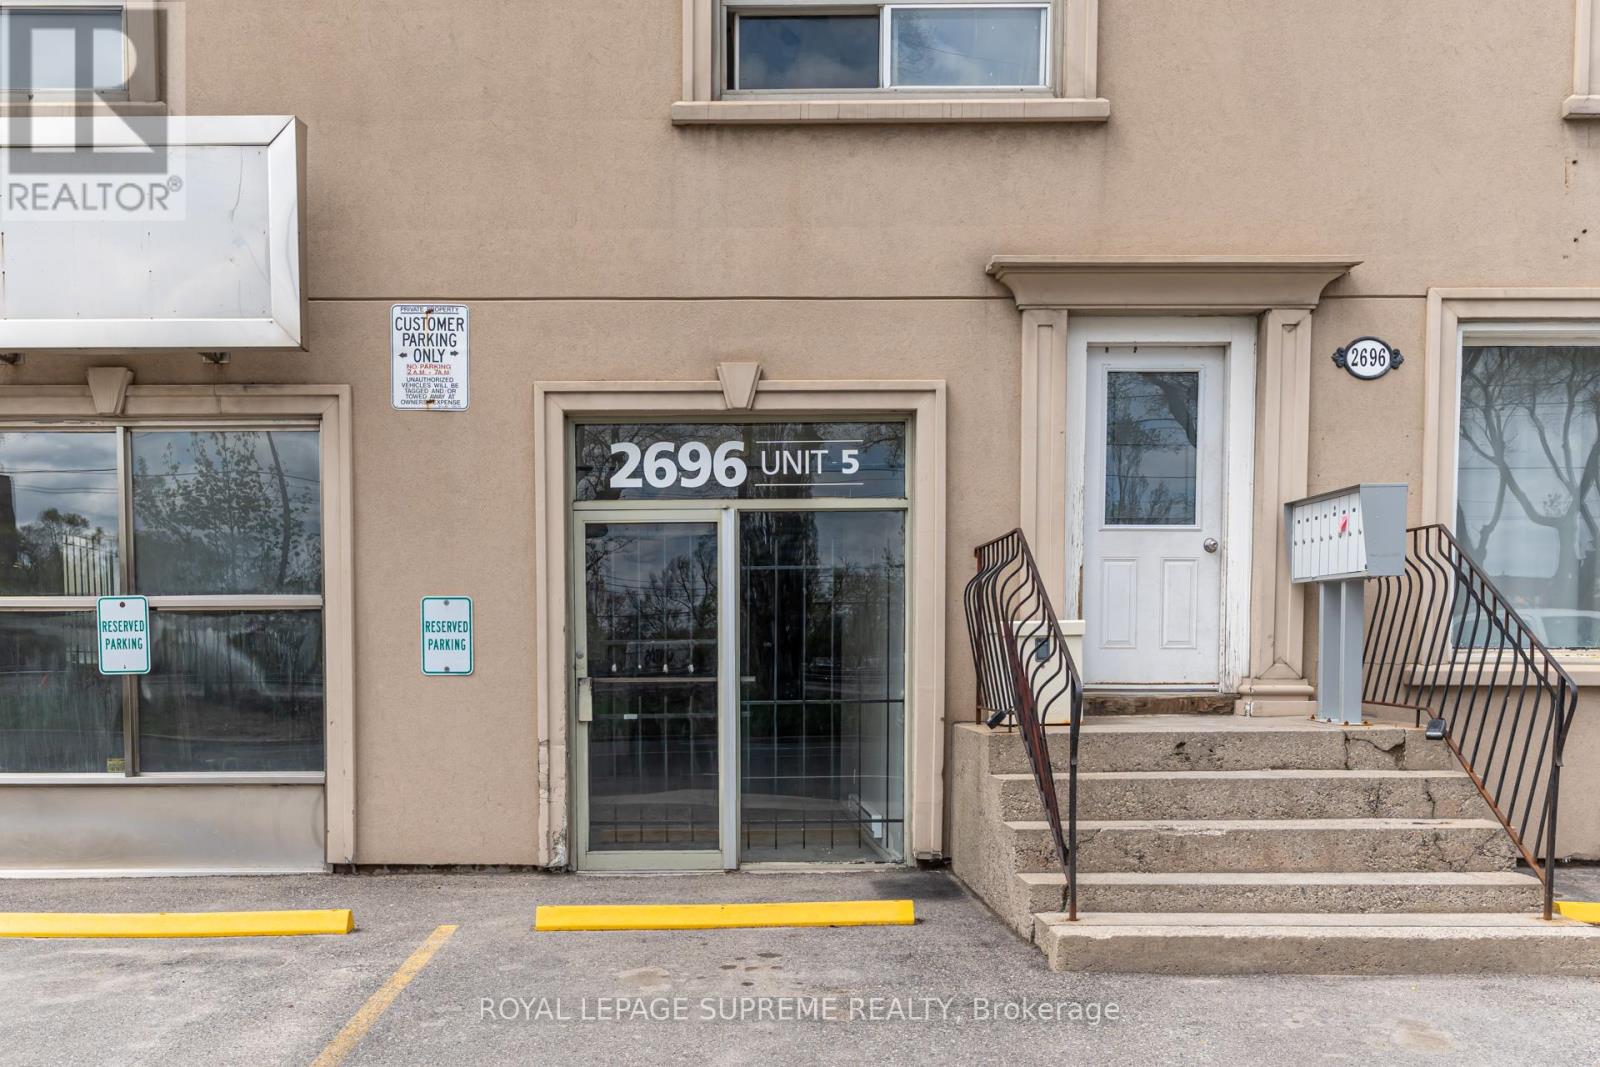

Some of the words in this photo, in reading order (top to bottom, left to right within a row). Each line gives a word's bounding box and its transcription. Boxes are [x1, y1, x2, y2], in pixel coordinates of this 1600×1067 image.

[395, 317, 464, 331] CUSTOMER
[402, 332, 457, 347] PARKING
[413, 348, 445, 363] ONLY
[1351, 348, 1386, 367] 2696
[609, 441, 748, 489] 2696
[760, 450, 829, 475] UNIT
[102, 620, 145, 633] RESERVED
[425, 620, 469, 633] RESERVED
[105, 638, 143, 650] PARKING
[428, 638, 467, 651] PARKING
